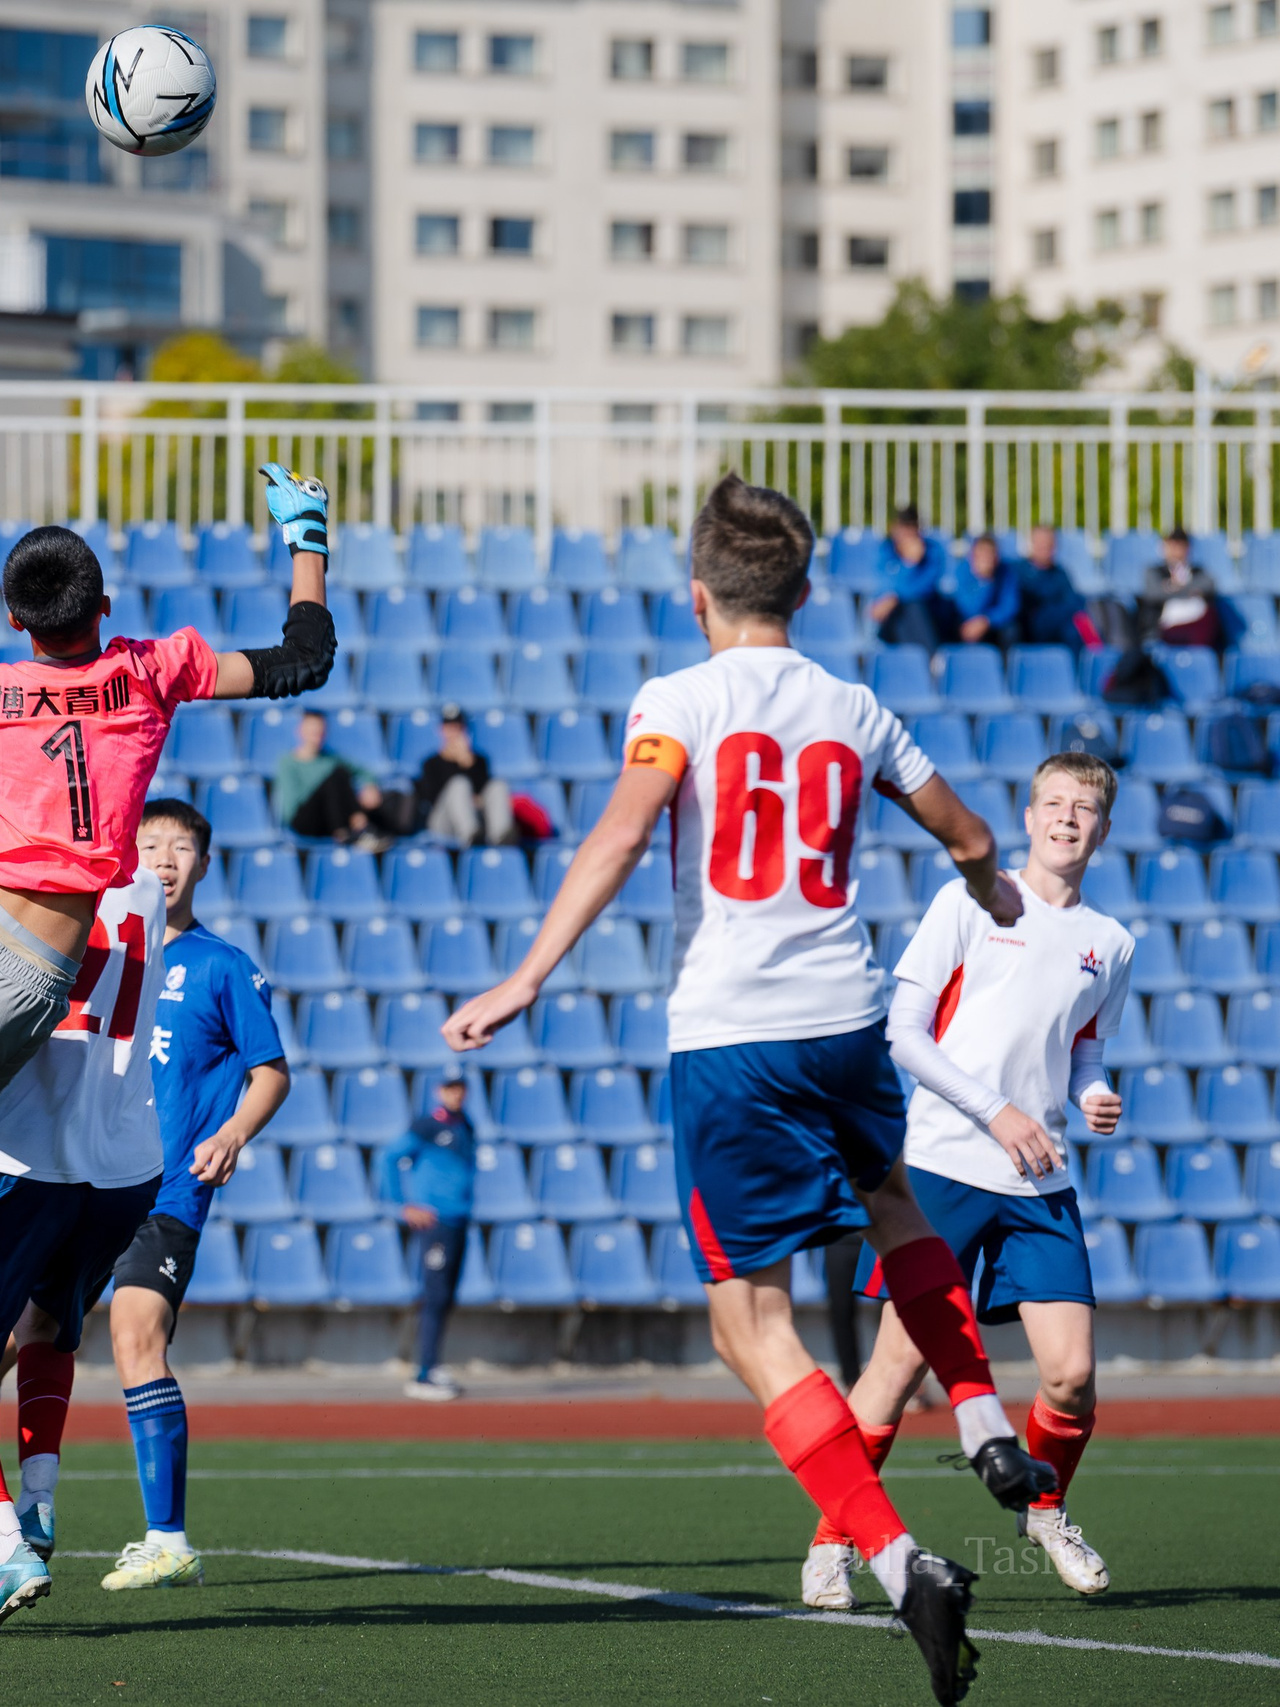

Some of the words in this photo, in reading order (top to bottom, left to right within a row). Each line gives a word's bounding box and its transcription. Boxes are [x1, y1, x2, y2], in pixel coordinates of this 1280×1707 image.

[40, 720, 94, 842] 1
[631, 738, 661, 764] C
[709, 731, 863, 909] 69
[54, 911, 146, 1042] 21
